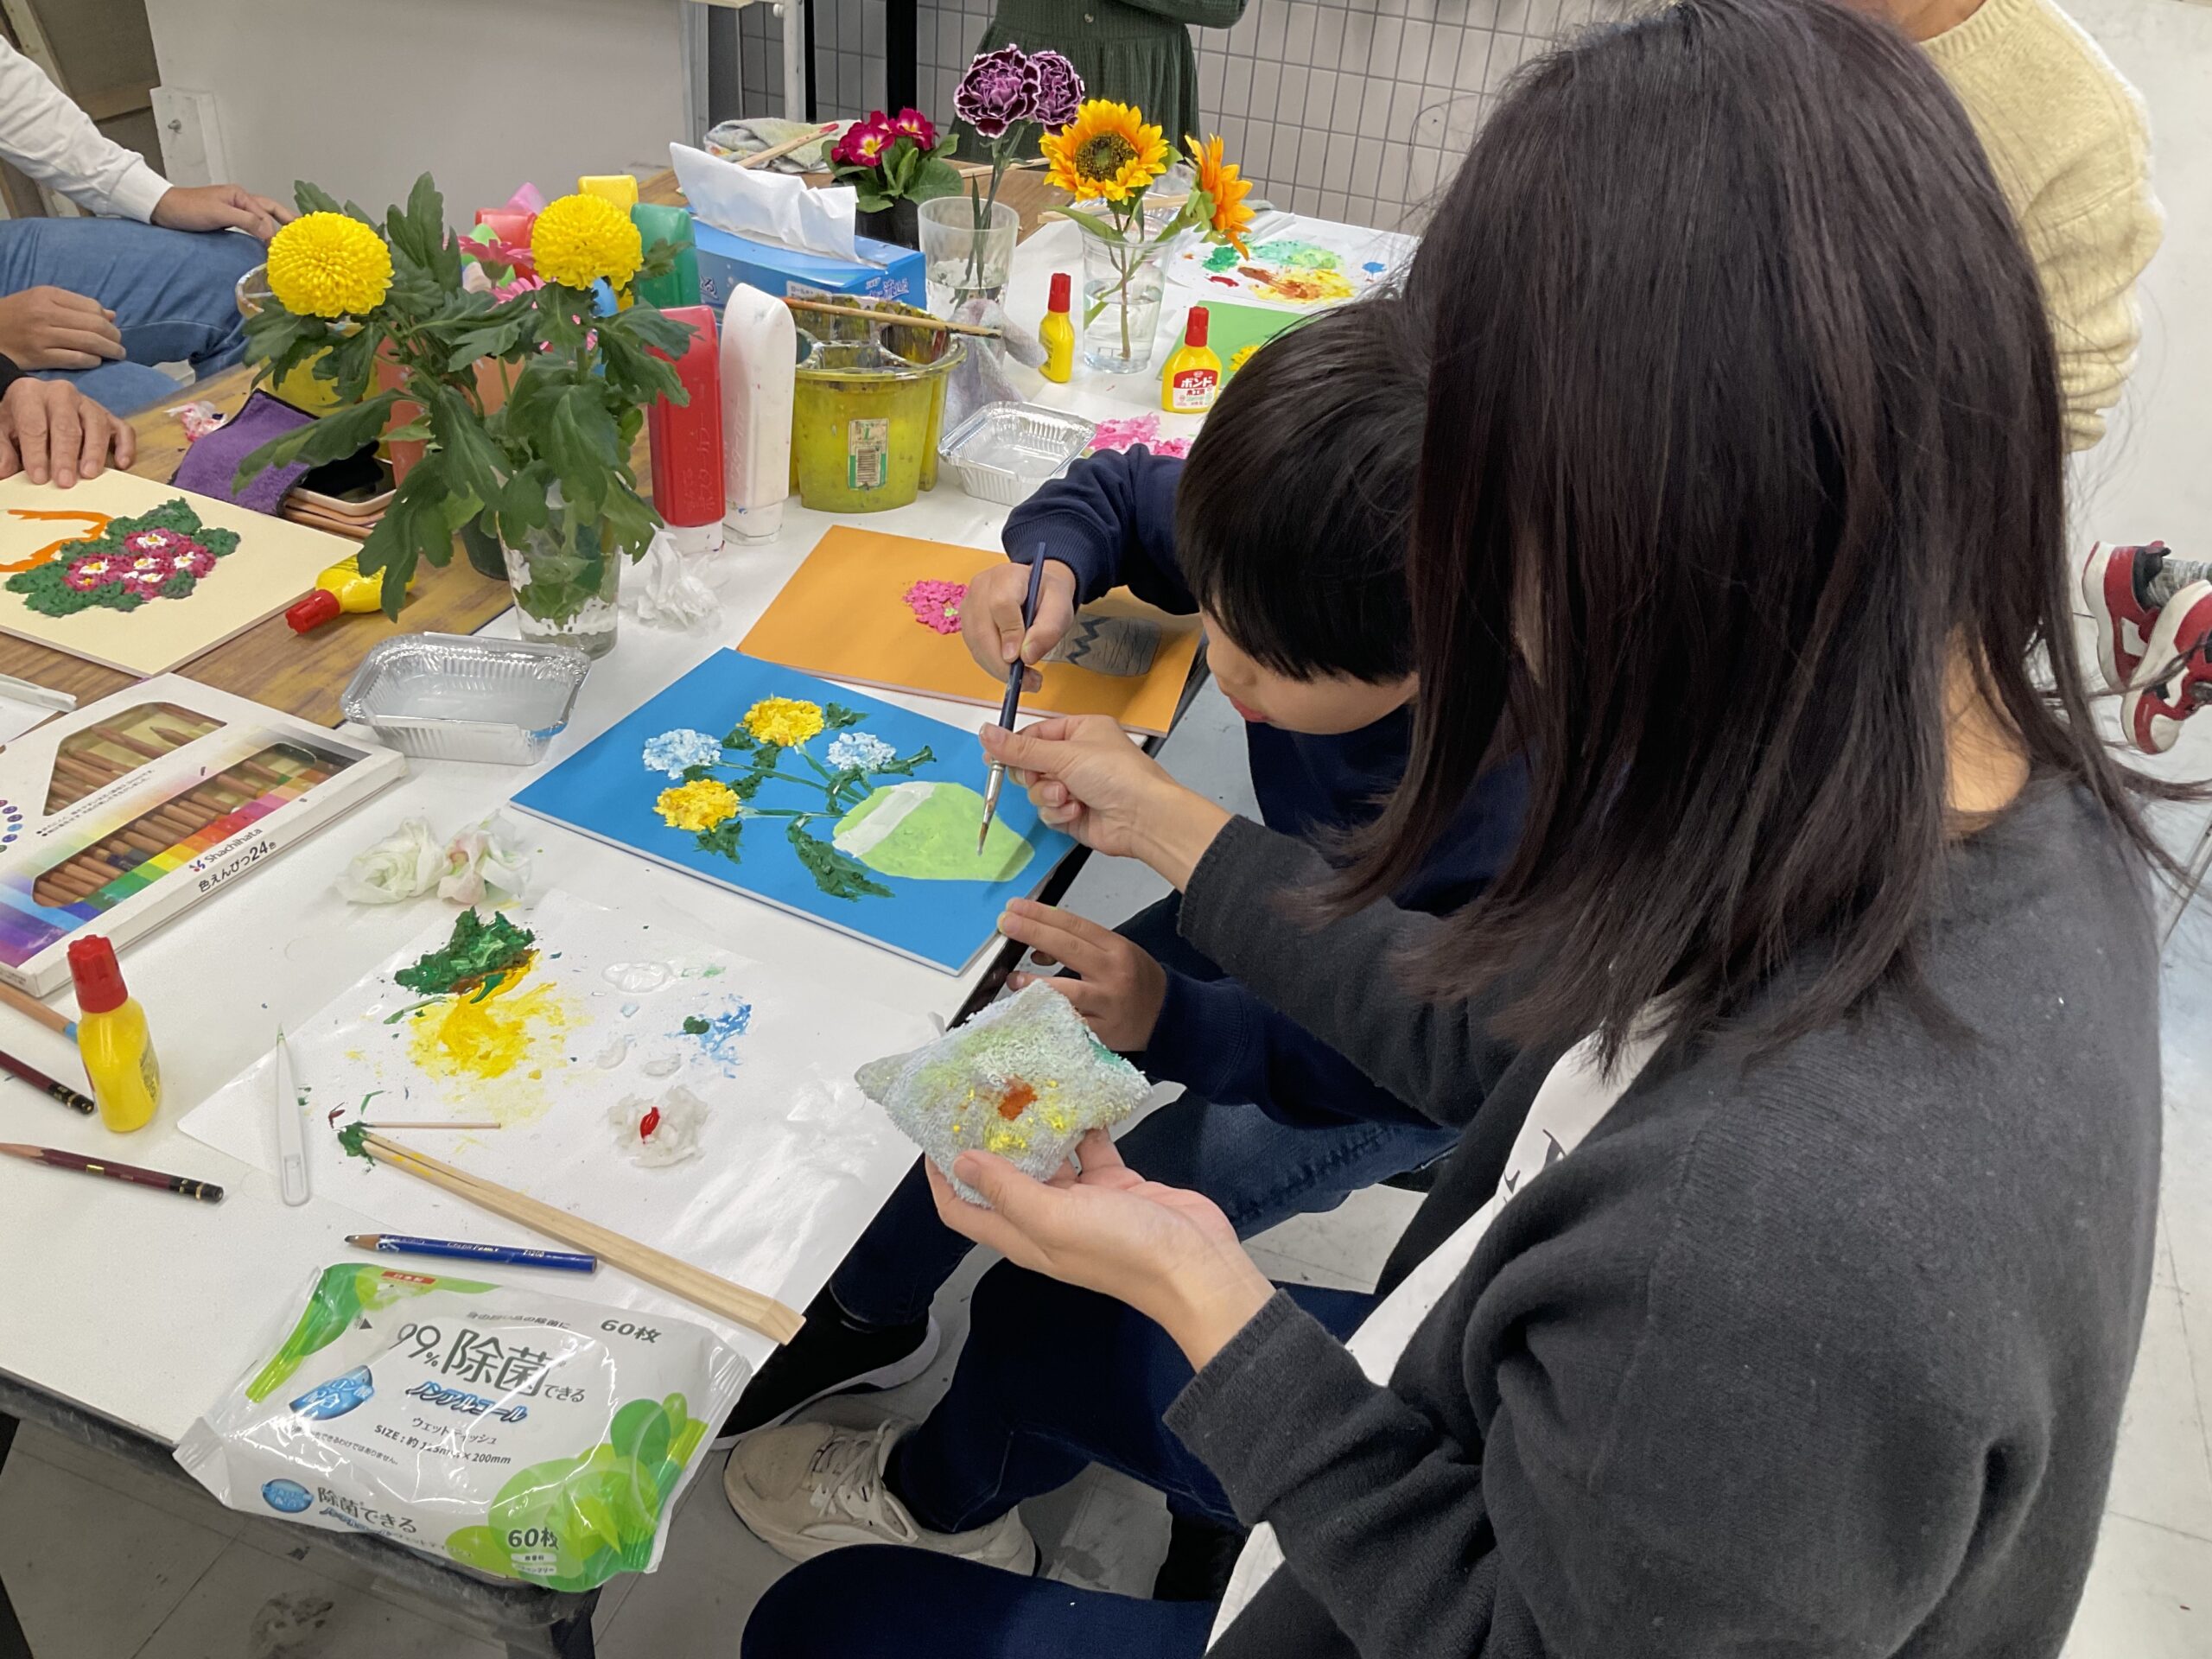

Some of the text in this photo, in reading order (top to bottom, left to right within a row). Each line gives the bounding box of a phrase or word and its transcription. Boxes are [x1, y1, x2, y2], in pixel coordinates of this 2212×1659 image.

[1181, 376, 1213, 388] ボンド
[205, 829, 263, 862] Shachihata
[199, 841, 276, 893] 色えんぴつ24色
[601, 1319, 662, 1344] 60枚
[405, 1381, 527, 1423] ノンアルコール
[508, 1527, 559, 1550] 60枚
